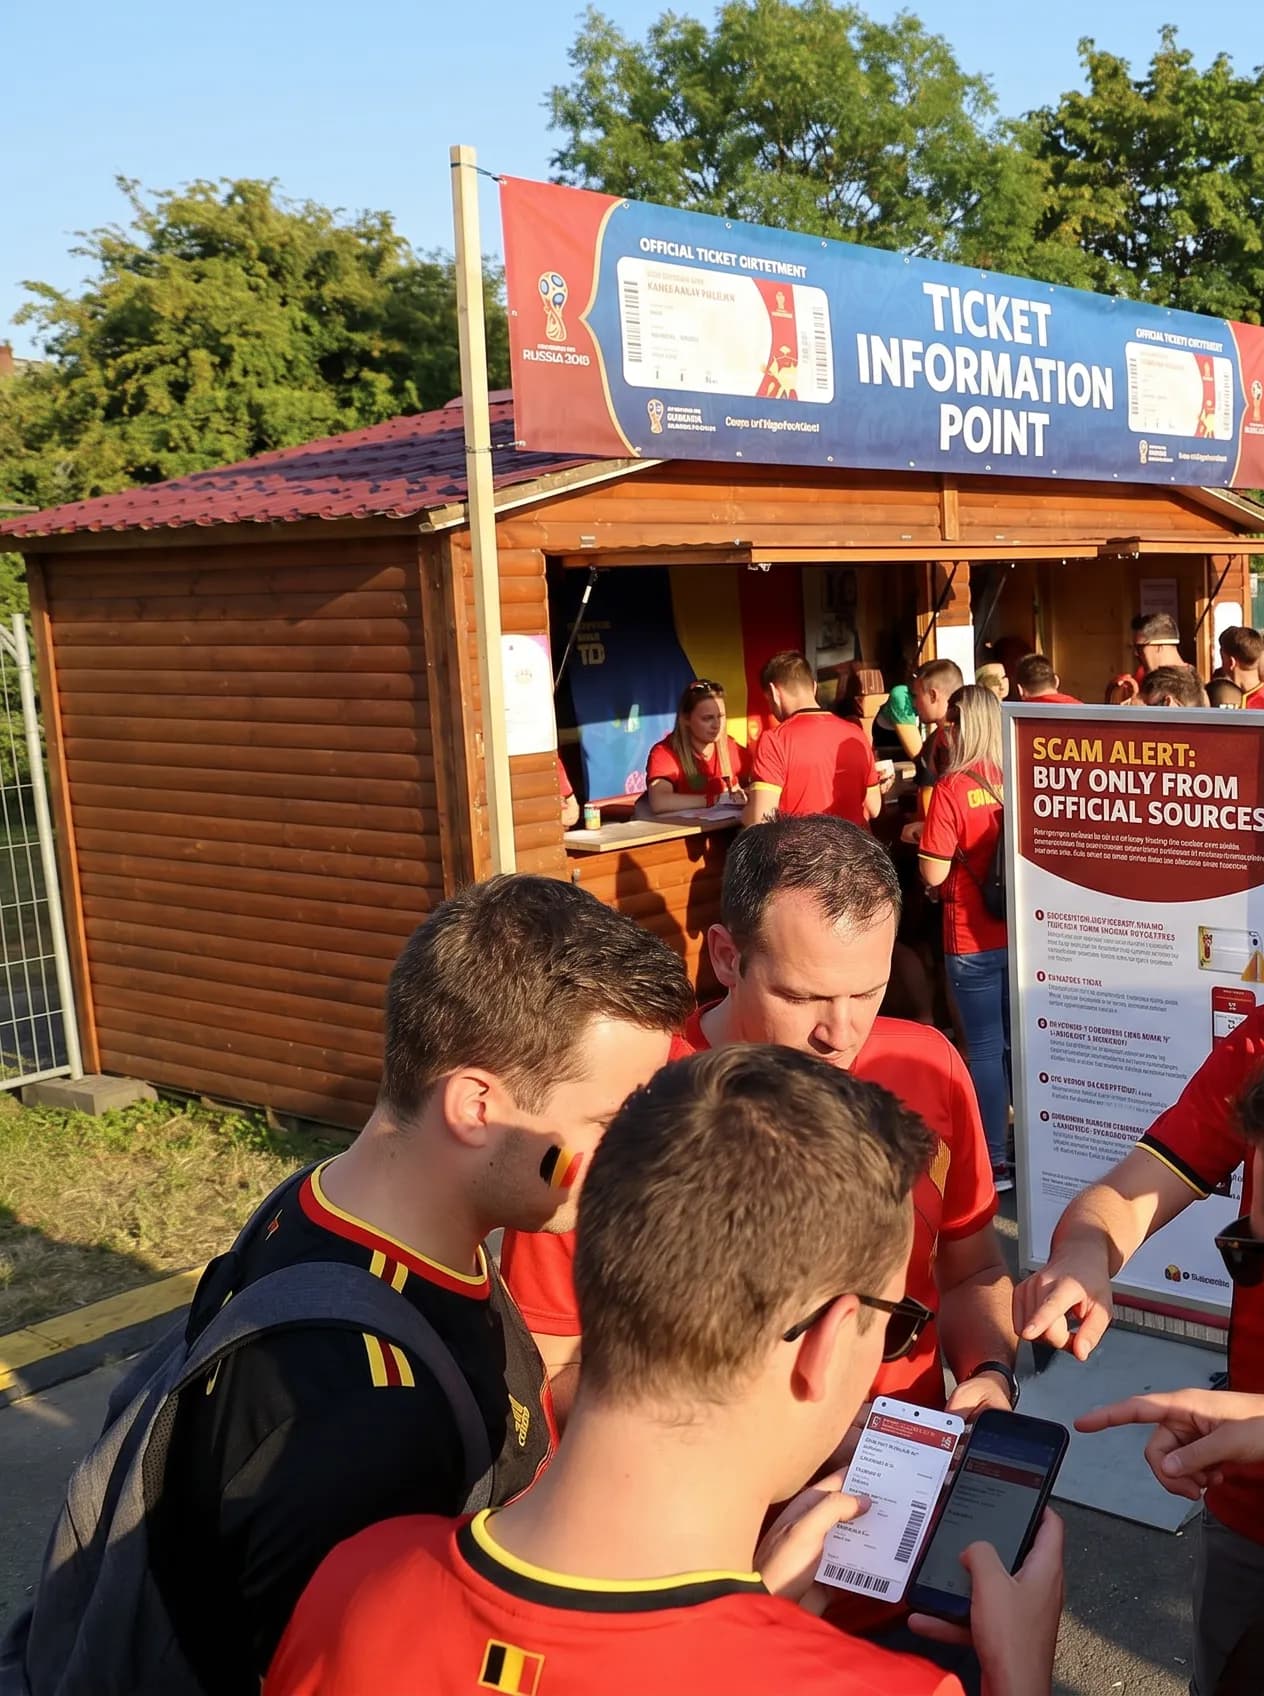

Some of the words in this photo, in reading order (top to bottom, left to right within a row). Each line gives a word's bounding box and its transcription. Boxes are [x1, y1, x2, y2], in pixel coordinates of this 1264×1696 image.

[640, 237, 694, 260] OFFICIAL
[696, 247, 738, 268] TICKET
[922, 281, 1053, 348] TICKET
[522, 349, 563, 364] RUSSIA
[856, 332, 1114, 411] INFORMATION
[938, 403, 1050, 457] POINT
[1032, 737, 1103, 763] SCAM
[1109, 740, 1196, 768] ALERT:
[1033, 766, 1083, 791] BUY
[1088, 769, 1157, 796] ONLY
[1162, 773, 1239, 800] FROM
[1033, 794, 1142, 824] OFFICIAL
